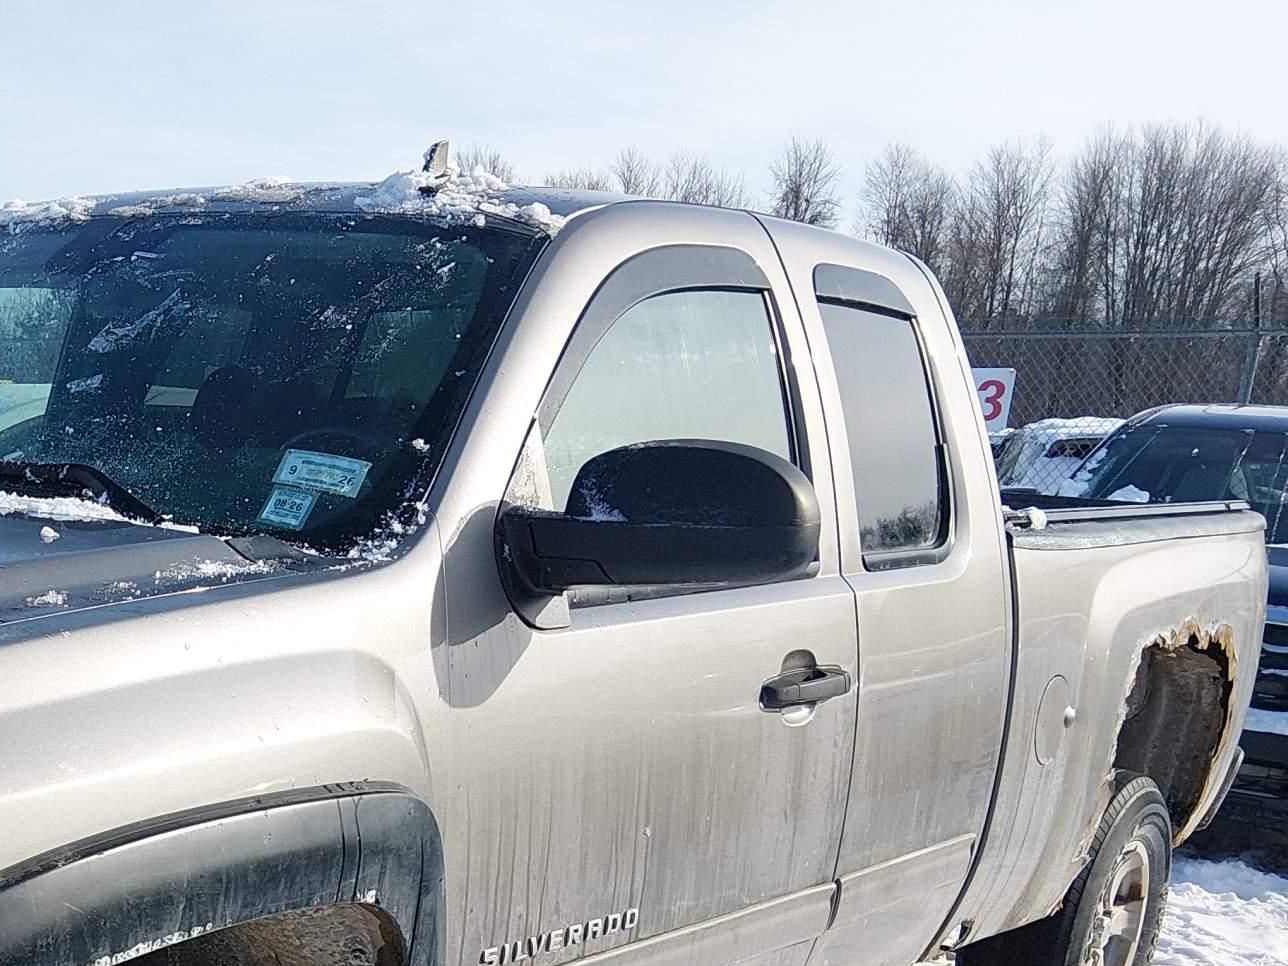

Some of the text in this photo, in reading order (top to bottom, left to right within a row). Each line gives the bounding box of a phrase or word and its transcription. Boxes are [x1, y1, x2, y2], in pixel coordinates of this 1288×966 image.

[977, 379, 1006, 421] 3
[289, 465, 298, 475] 9
[337, 475, 356, 487] 26
